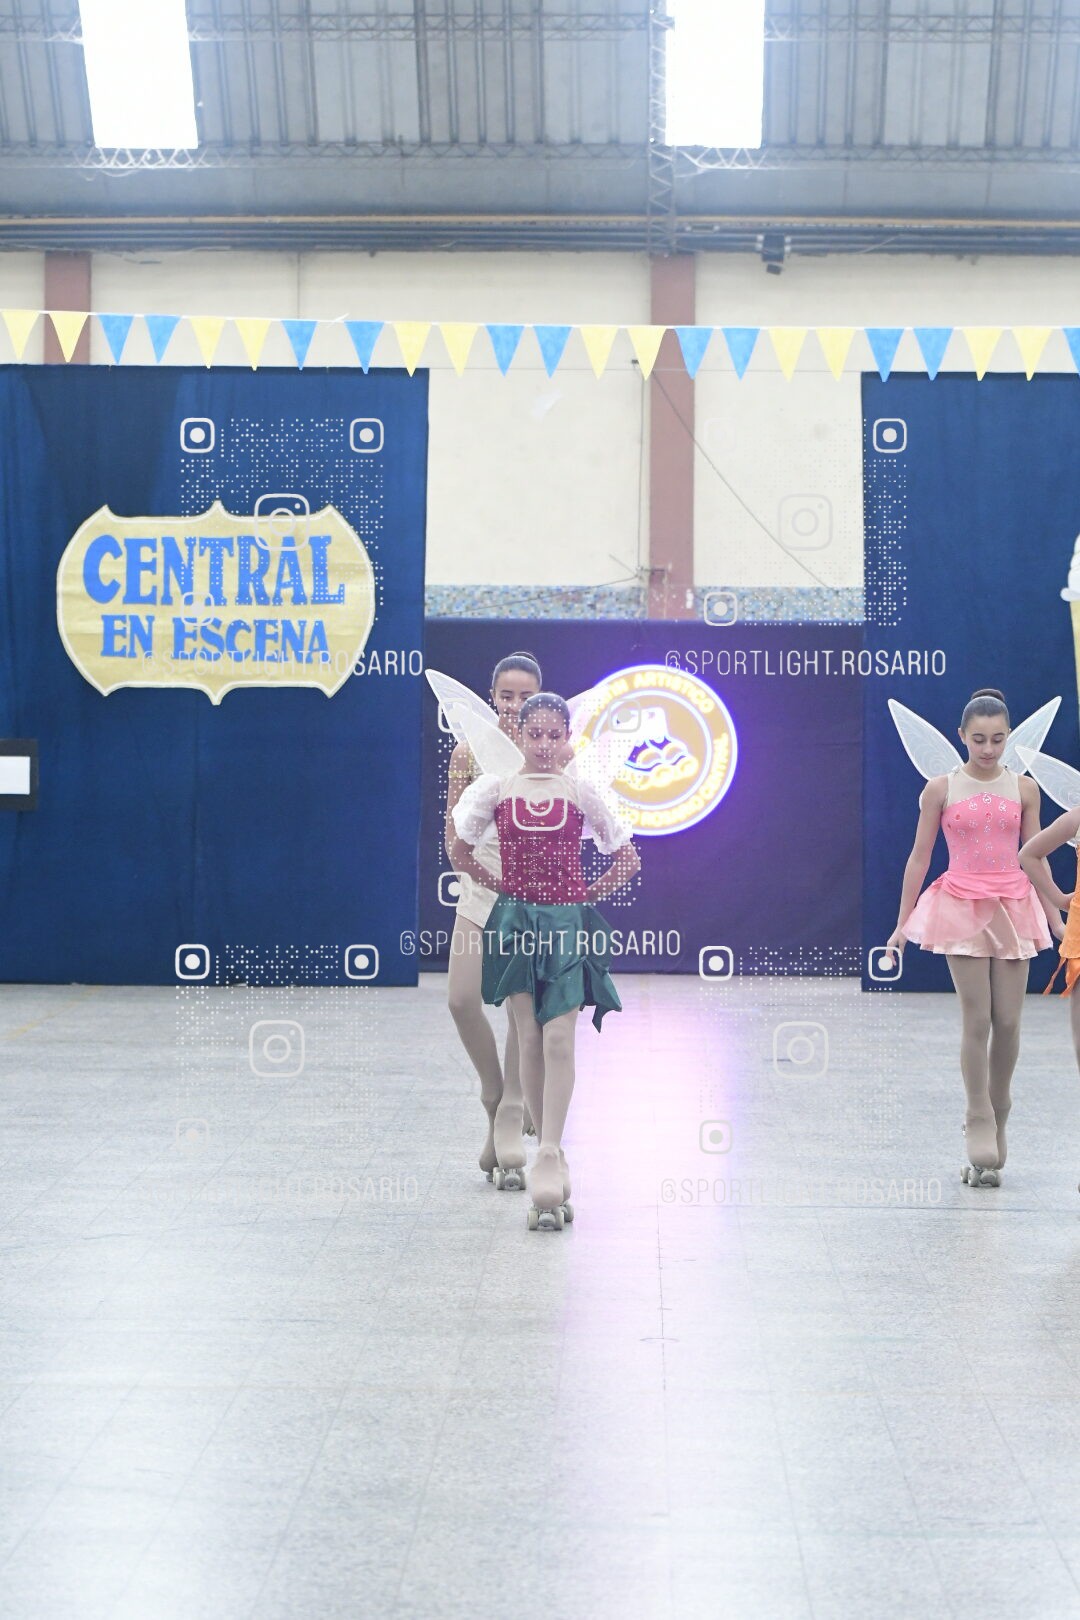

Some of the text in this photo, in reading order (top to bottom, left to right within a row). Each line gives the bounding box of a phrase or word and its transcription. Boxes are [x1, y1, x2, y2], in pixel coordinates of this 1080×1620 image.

[82, 534, 345, 606] CENTRAL
[100, 614, 332, 664] EN ESCENA
